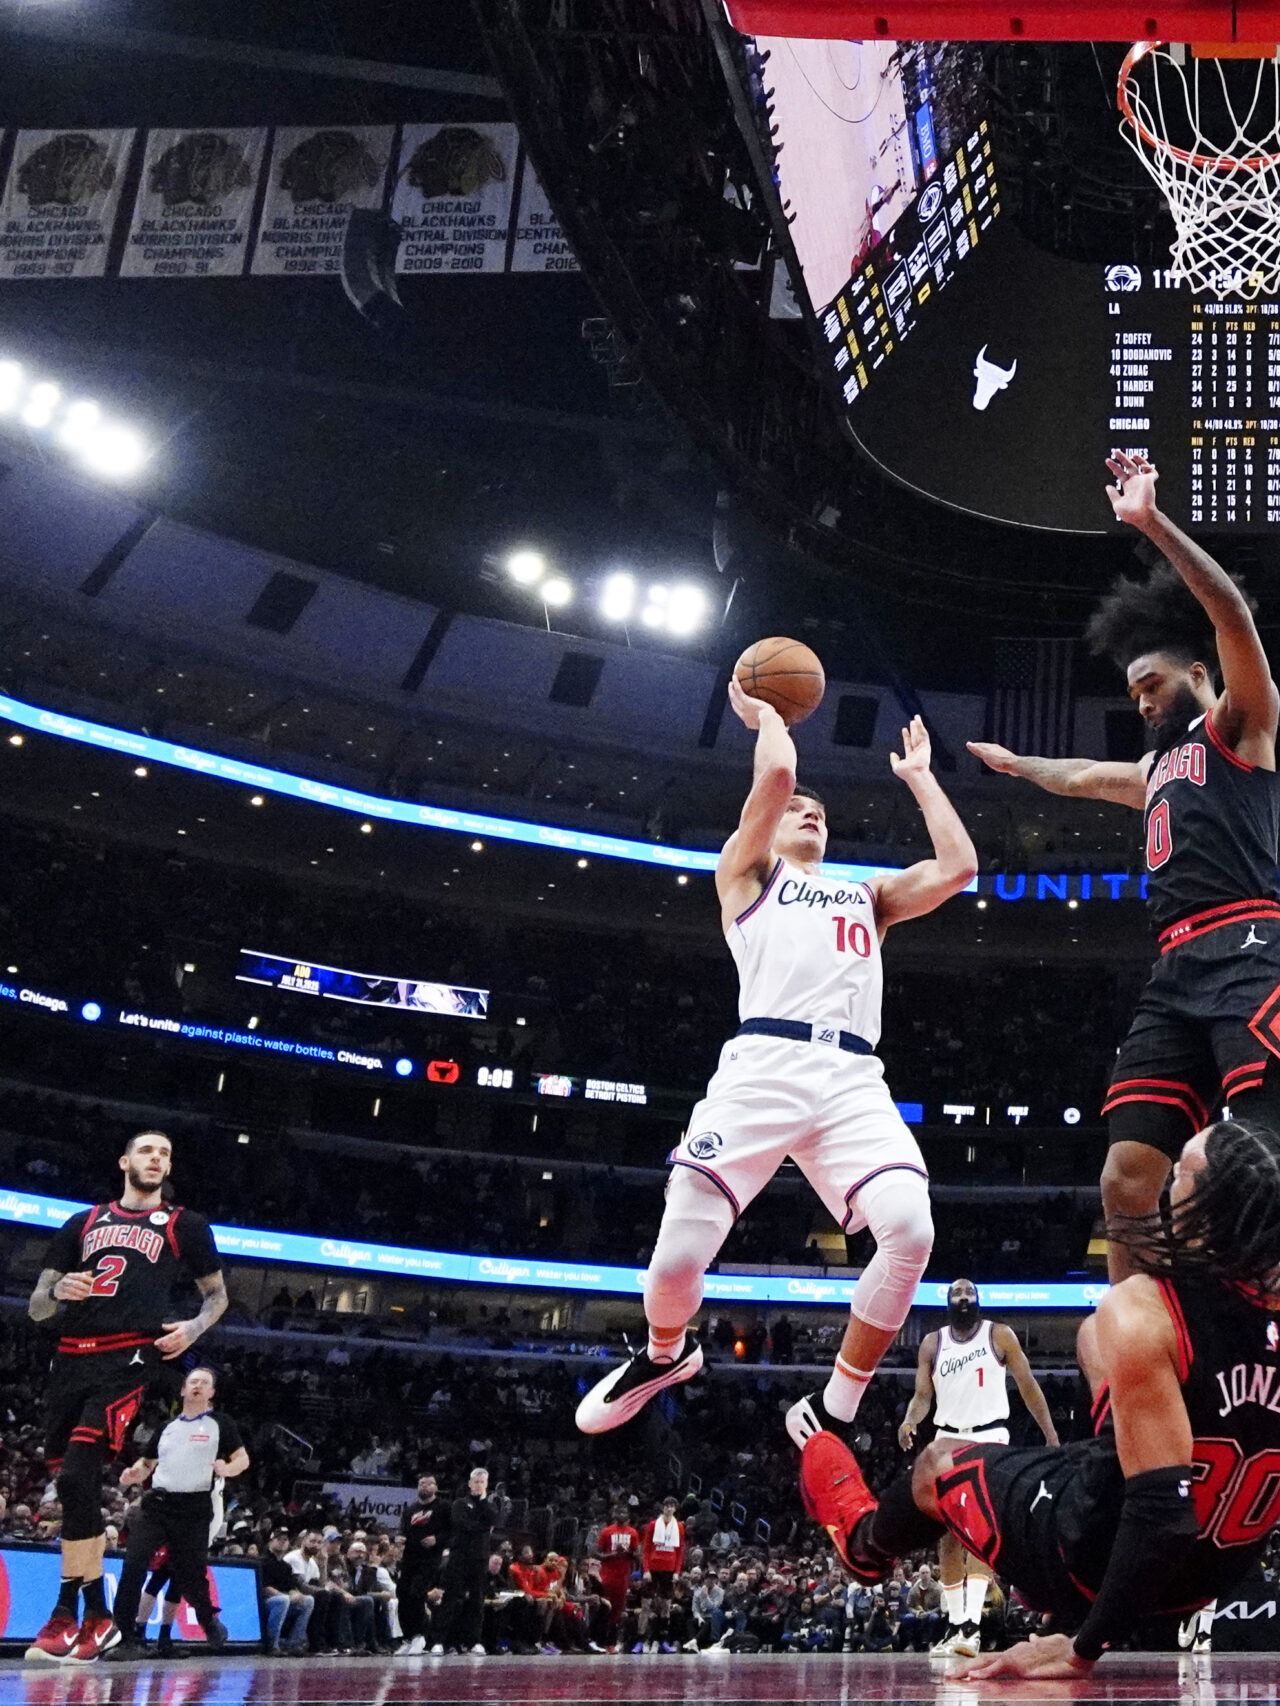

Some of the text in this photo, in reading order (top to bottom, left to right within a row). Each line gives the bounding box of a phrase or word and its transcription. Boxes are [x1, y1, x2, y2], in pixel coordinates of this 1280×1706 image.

[422, 202, 481, 214] CHICAGO
[402, 214, 496, 227] BLACKHAWKS
[400, 228, 506, 242] ENTRAL DIVISION
[405, 242, 485, 256] CHAMPIONS
[403, 258, 483, 270] 2009-2010
[908, 242, 928, 286] 1:54
[1108, 303, 1120, 314] LA
[1212, 322, 1216, 330] F
[1226, 322, 1238, 330] PTS
[1122, 333, 1152, 345] COFFEY
[1192, 333, 1202, 345] 24
[1226, 333, 1238, 345] 20
[1246, 333, 1252, 345] 2
[1227, 349, 1237, 361] 14
[1110, 365, 1120, 376] 40
[1122, 365, 1148, 376] ZUBAC
[1192, 365, 1202, 376] 27
[1212, 365, 1218, 376] 2
[1122, 380, 1154, 392] HARDEN
[1226, 380, 1236, 392] 25
[1123, 396, 1144, 408] DUNN
[1192, 396, 1202, 408] 24
[1110, 418, 1150, 430] CHICAGO
[1192, 448, 1202, 460] 17
[1246, 448, 1252, 460] 2
[1226, 464, 1236, 476] 21
[1226, 480, 1236, 492] 21
[1246, 495, 1252, 506] 4
[1227, 510, 1236, 522] 14
[1146, 798, 1172, 872] 0
[777, 879, 866, 909] Clippers
[995, 873, 1148, 901] UNIT
[832, 916, 871, 958] 10
[294, 965, 311, 978] ADO
[282, 974, 296, 986] JULY
[20, 989, 68, 1012] Chicago.
[120, 1011, 382, 1069] Let's unite against plastic water bottles, Chicago.
[477, 1067, 513, 1088] 9:05
[586, 1079, 644, 1095] BOSTON CELTICS
[585, 1088, 647, 1104] DETROIT PISTONS
[82, 1224, 164, 1263] CHICAGO
[320, 1238, 372, 1266] Culligan
[89, 1255, 127, 1296] 2
[478, 1259, 530, 1282] Culligan
[787, 1280, 836, 1300] Culligan
[940, 1347, 987, 1377] Clippers
[976, 1368, 984, 1387] 1
